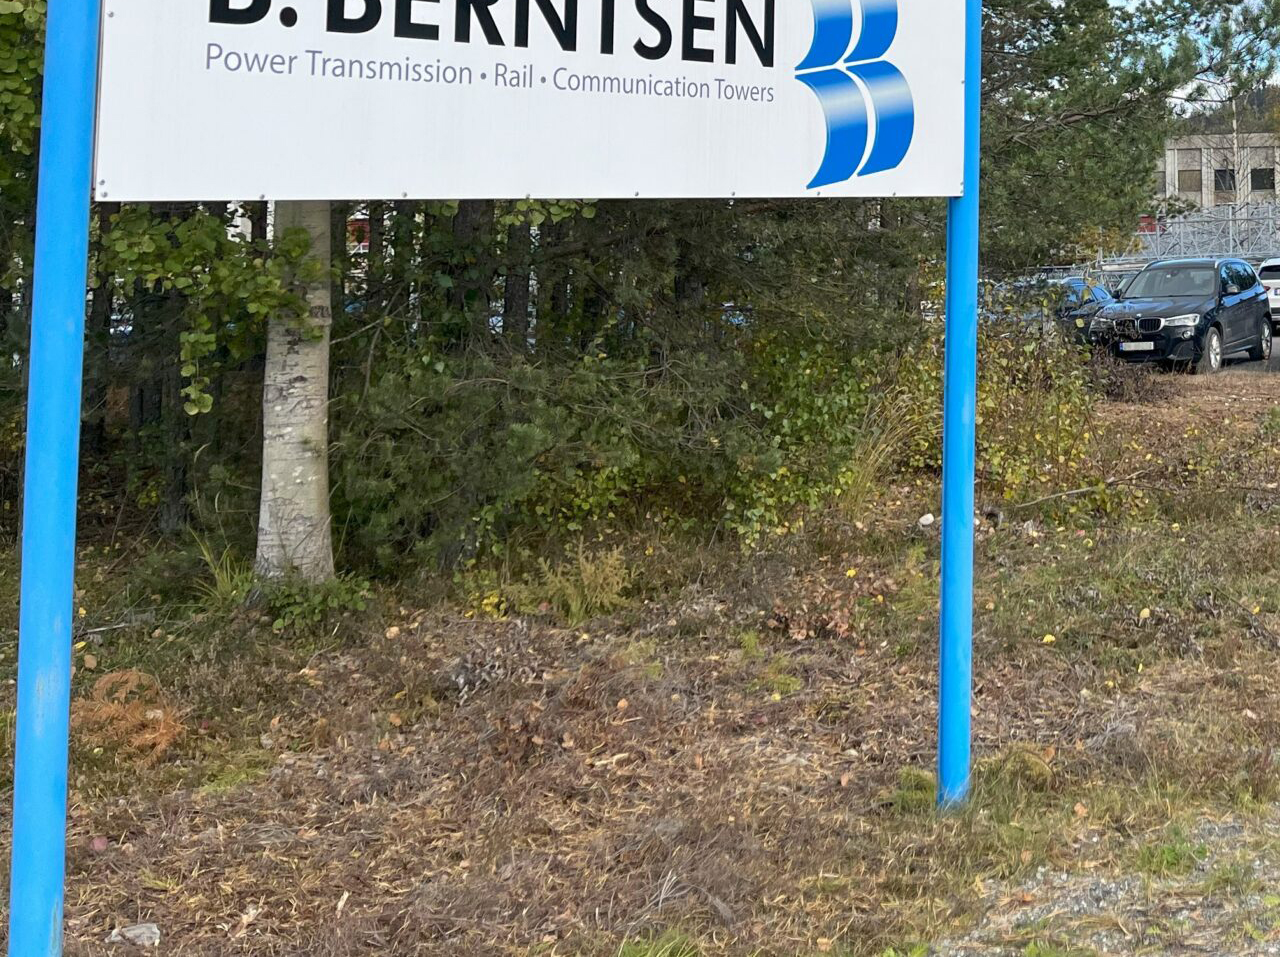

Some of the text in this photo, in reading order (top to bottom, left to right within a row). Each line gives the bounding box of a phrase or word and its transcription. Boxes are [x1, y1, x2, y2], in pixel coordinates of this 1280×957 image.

[206, 42, 775, 104] Power Transmission Rail Communication Towers
